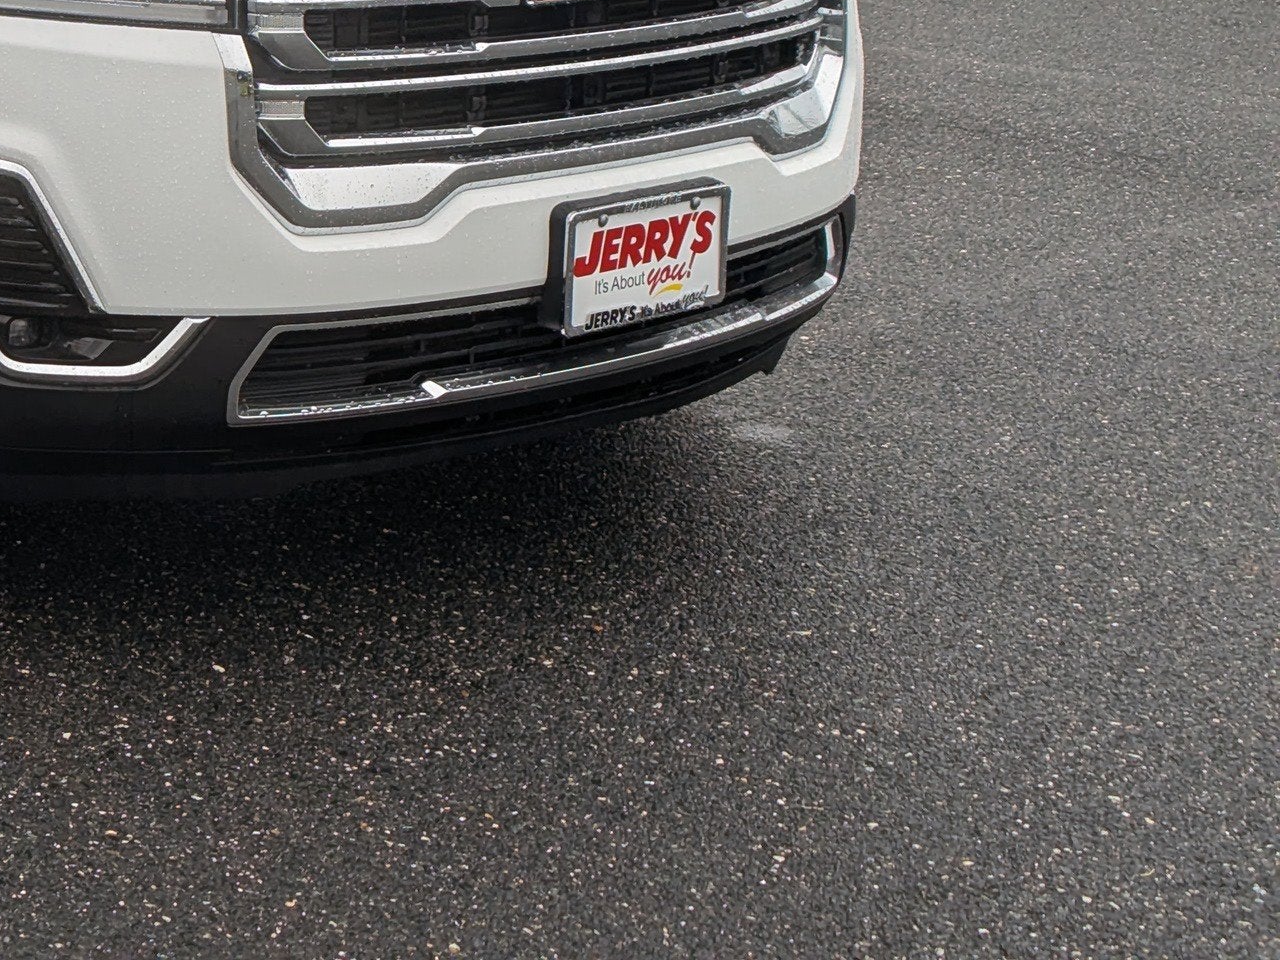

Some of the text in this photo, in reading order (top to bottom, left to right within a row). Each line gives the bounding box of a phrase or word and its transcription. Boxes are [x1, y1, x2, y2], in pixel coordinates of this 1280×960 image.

[572, 209, 717, 278] JERRY'S
[594, 252, 695, 296] It's About you!
[584, 304, 638, 331] JERRY'S
